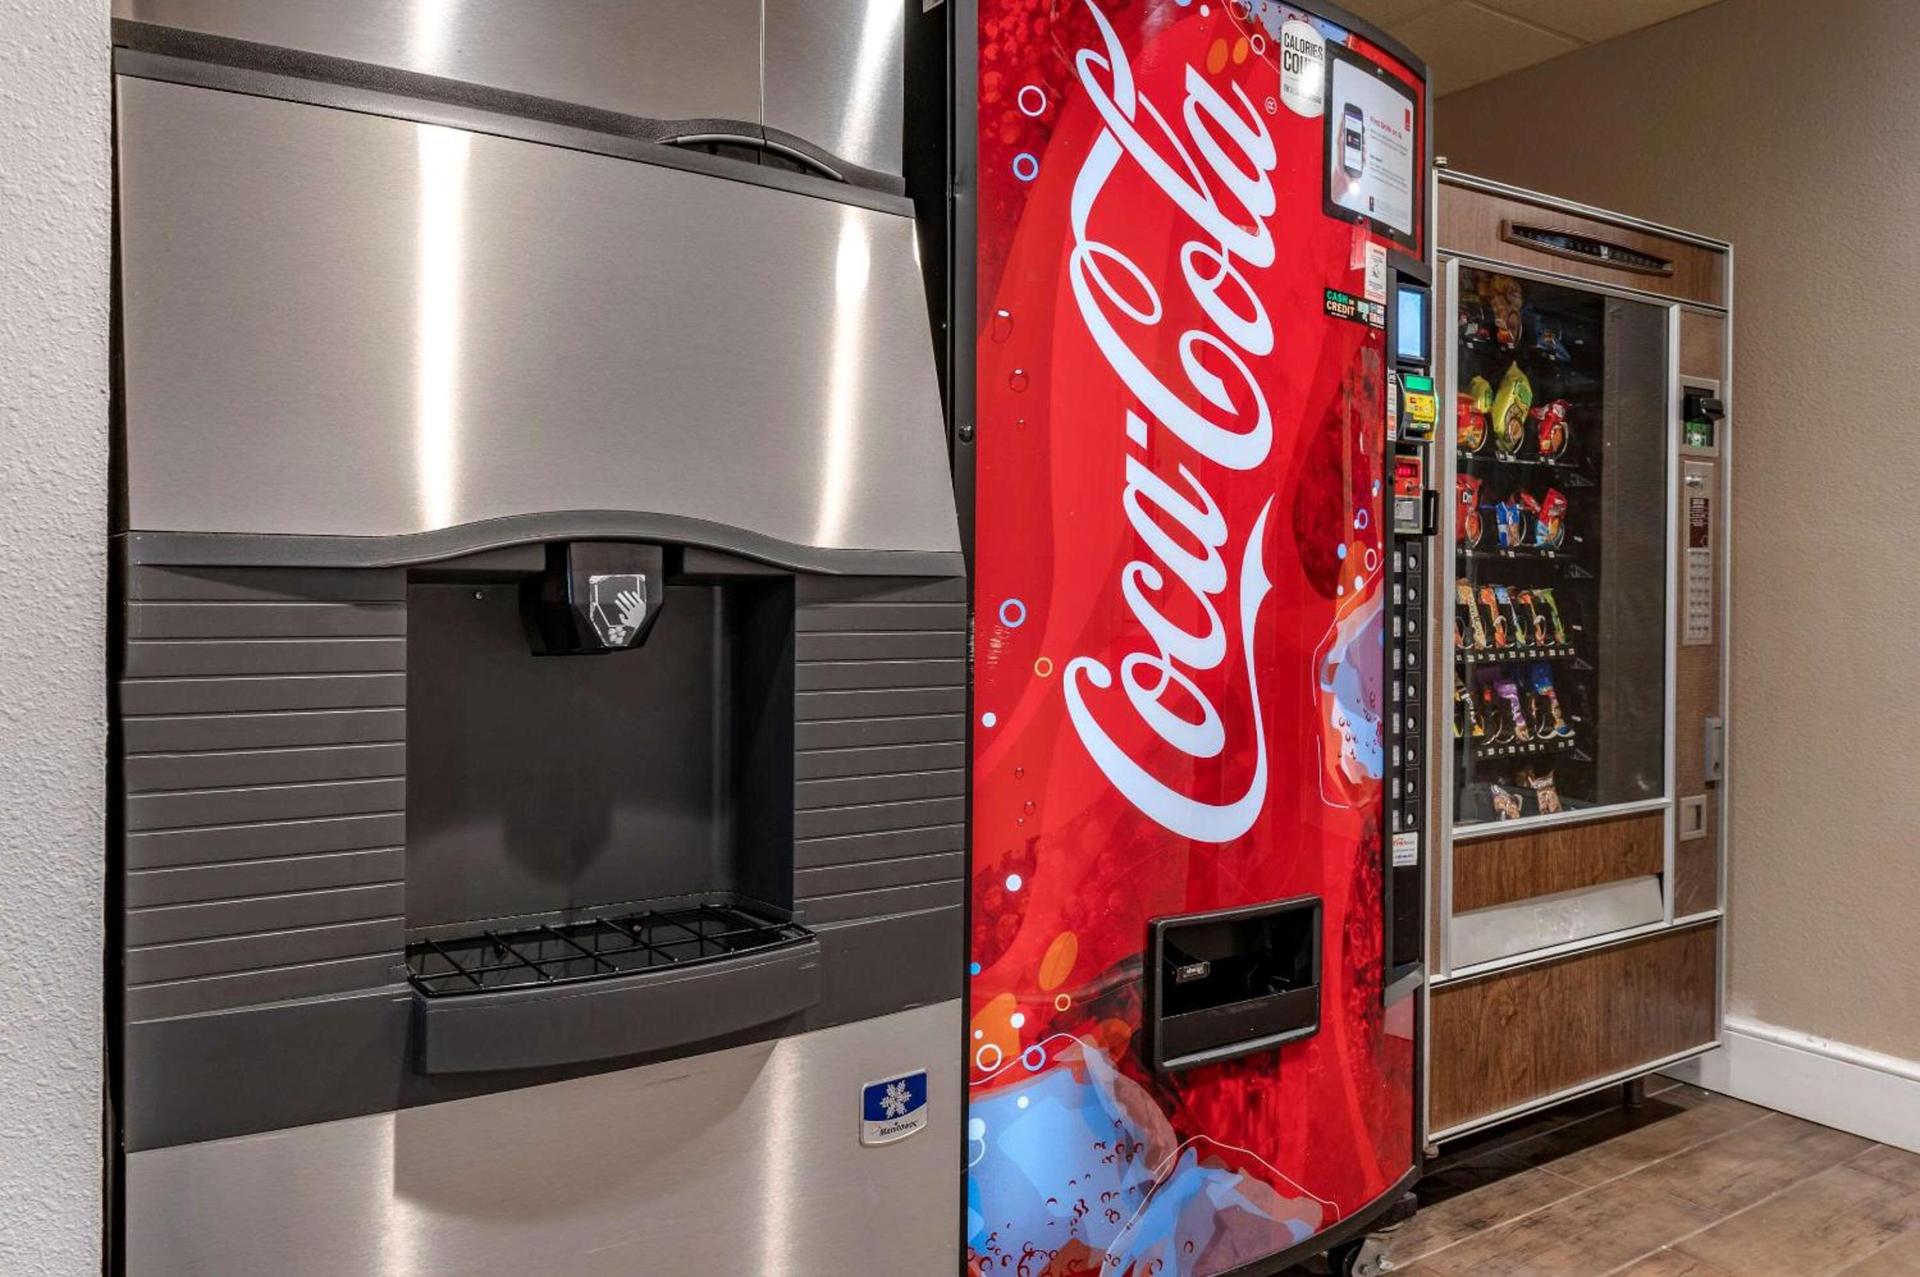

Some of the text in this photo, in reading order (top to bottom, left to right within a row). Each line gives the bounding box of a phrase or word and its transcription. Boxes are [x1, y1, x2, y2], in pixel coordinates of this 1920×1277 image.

[1283, 32, 1324, 61] CALORIES
[1326, 290, 1349, 305] CASH
[1326, 300, 1355, 317] CREDIT
[1063, 0, 1278, 843] Coca-Cola
